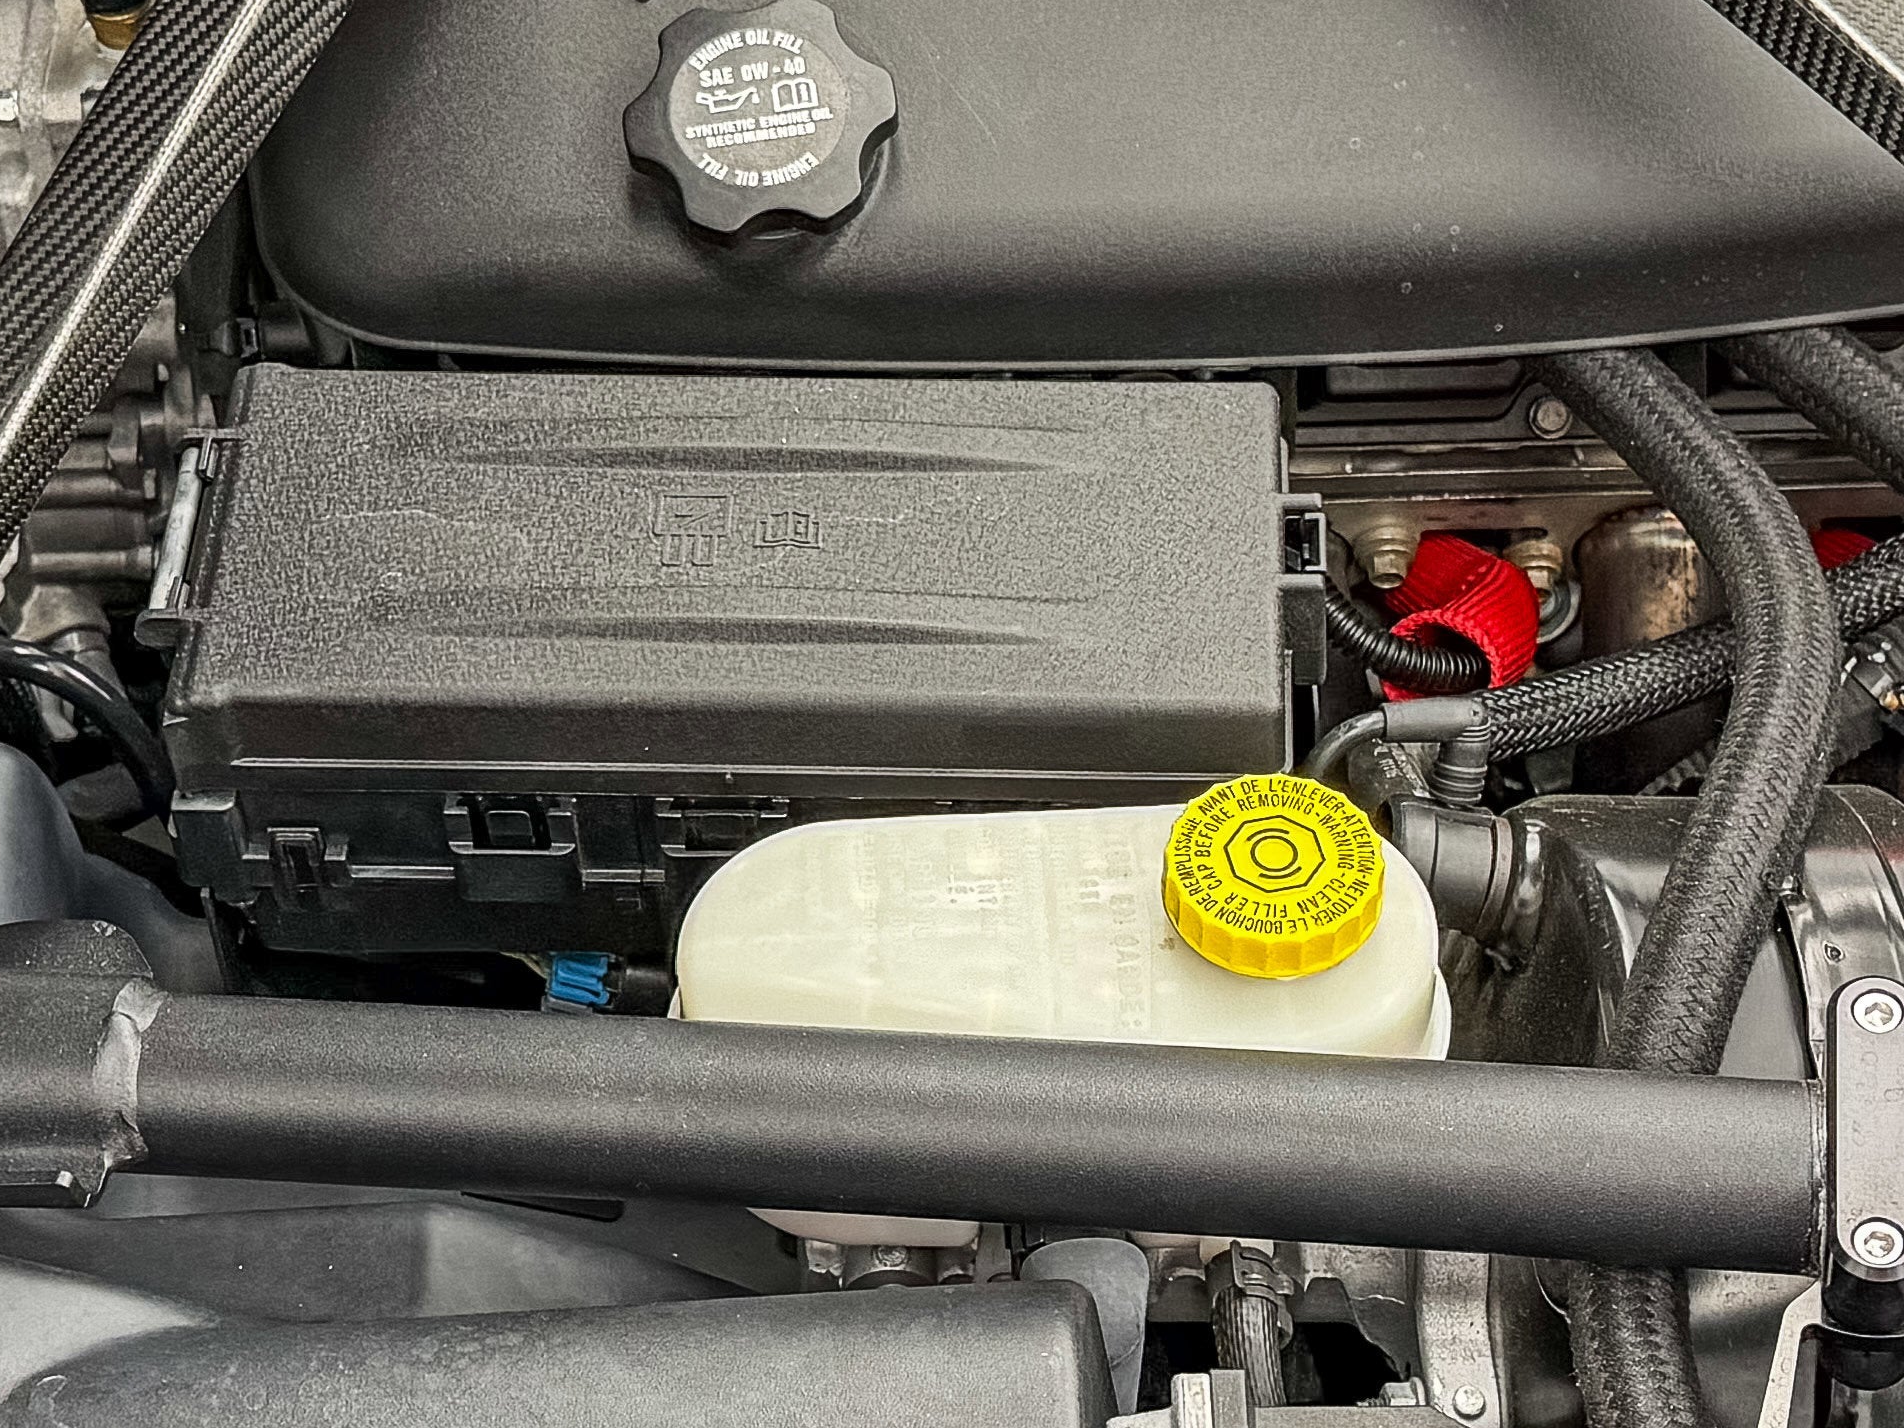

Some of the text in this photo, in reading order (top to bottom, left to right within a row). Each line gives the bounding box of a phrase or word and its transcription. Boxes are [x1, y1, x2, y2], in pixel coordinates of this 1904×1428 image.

[689, 28, 804, 70] ENGINE OIL FILL
[698, 66, 735, 88] SAE
[685, 106, 834, 140] SYNTHETIC ENGINE OIL
[705, 121, 816, 149] RECOMMENDED
[697, 151, 820, 188] ENGINE OIL FILL
[1197, 785, 1237, 816] AVANT
[1240, 778, 1262, 795] DE
[1236, 792, 1313, 816] REMOVING
[1193, 806, 1236, 858] BEFORE
[1196, 863, 1224, 891] CAP
[1195, 892, 1219, 912] DE
[1223, 891, 1288, 919] FILLER
[1295, 877, 1347, 915] CLEAN
[1213, 905, 1284, 935] BOUCHON
